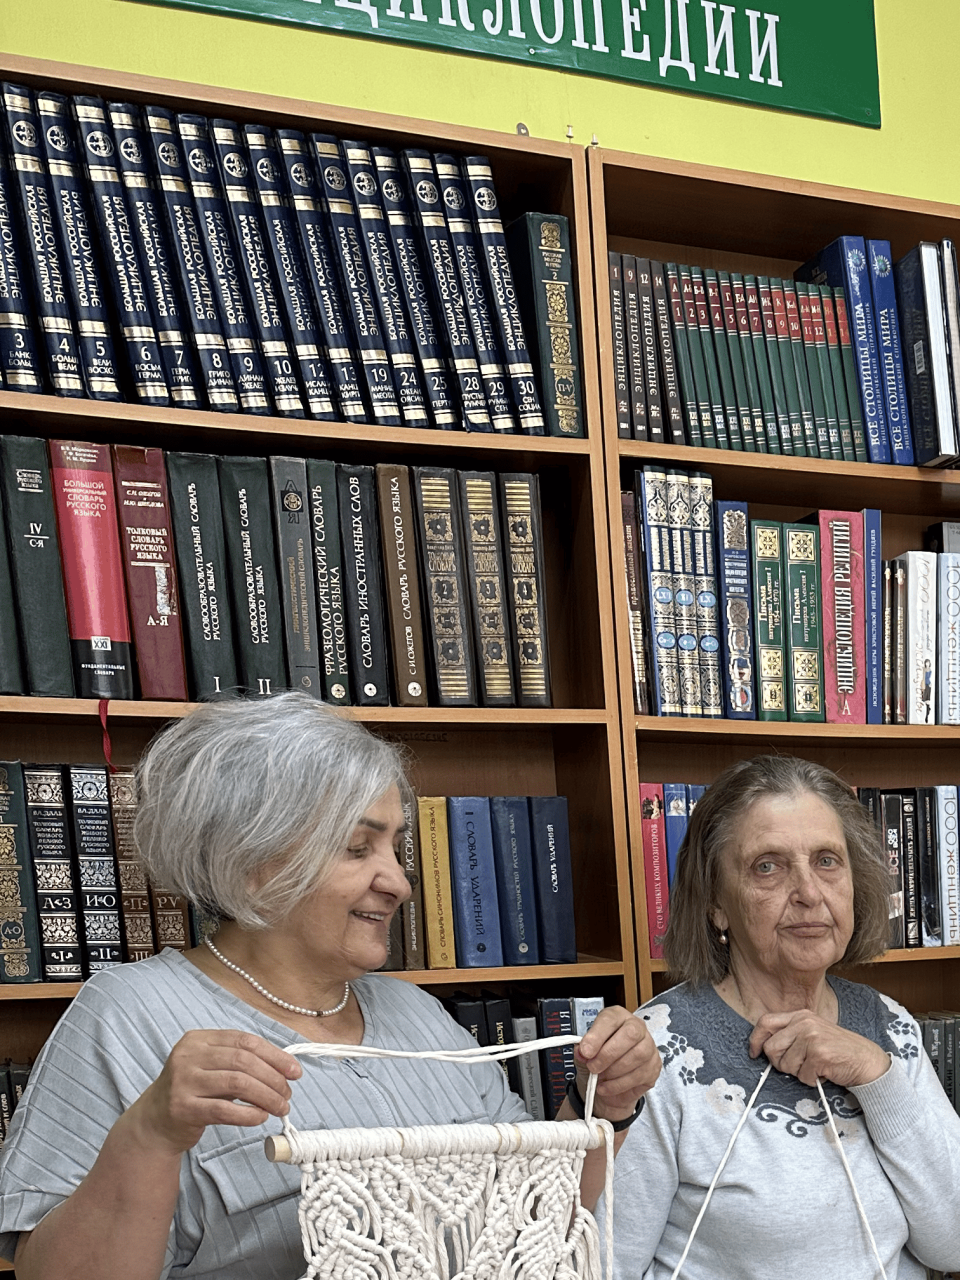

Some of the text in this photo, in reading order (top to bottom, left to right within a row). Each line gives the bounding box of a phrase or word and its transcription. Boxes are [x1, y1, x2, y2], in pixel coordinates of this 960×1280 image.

[302, 0, 783, 87] ЛОПЕДИИ
[15, 333, 24, 348] 3
[59, 338, 69, 352] 4
[96, 342, 105, 356] 5
[613, 290, 625, 390] ЭНЦИКЛОПЕДИЯ
[629, 293, 642, 392] ЭНЦИКЛОПЕДИЯ
[643, 296, 657, 395] ЭНЦИКЛОПЕДИЯ
[658, 299, 676, 397] ЭНЦИКЛОПЕДИЯ
[141, 346, 151, 360] 6
[175, 350, 183, 364] 7
[213, 353, 222, 368] 8
[244, 358, 253, 371] 9
[274, 360, 291, 374] 10
[372, 368, 387, 382] 19
[401, 372, 416, 385] 24
[854, 303, 881, 446] ВСЕ СТОЛИЦЫ МИРА
[432, 377, 447, 390] 25
[464, 377, 479, 390] 28
[489, 382, 504, 396] 29
[519, 381, 534, 394] 30
[880, 308, 903, 450] ВСЕ СТОЛИЦЫ МИРА
[64, 480, 104, 489] БОЛЬШОЙ
[66, 502, 106, 510] РУССКОГО
[68, 494, 103, 503] СЛОВАРЬ
[74, 509, 101, 517] ЯЗЫКА
[30, 523, 42, 534] IV
[126, 527, 167, 536] ТОЛКОВЫЙ
[131, 535, 164, 543] СЛОВАРЬ
[130, 543, 167, 552] РУССКОГО
[391, 477, 412, 620] СЛОВАРЬ РУССКОГО ЯЗЫКА
[188, 482, 211, 640] СЛОВООБРАЗОВАТЕЛЬНЫЙ СЛОВАРЬ
[239, 488, 259, 643] СЛОВООБРАЗОВАТЕЛЬНЫЙ СЛОВАРЬ
[350, 477, 372, 668] СЛОВАРЬ ИНОСТРАННЫХ СЛОВ
[311, 485, 333, 676] ФРАЗЕОЛОГИЧЕСКИЙ СЛОВАРЬ
[947, 562, 960, 617] 1000
[207, 561, 221, 640] РУССКОГО ЯЗЫКА
[255, 566, 269, 643] РУССКОГО ЯЗЫКА
[758, 585, 767, 621] Письма
[829, 521, 855, 694] ЭНЦИКЛОПЕДИЯ РЕЛИГИЙ
[147, 615, 169, 626] А-Я
[329, 567, 348, 675] РУССКОГО ЯЗЫКА
[842, 700, 851, 715] А
[944, 793, 957, 845] 1000
[547, 825, 558, 893] СЛОВАРЬ УДАРЕНИЙ
[651, 824, 660, 880] КОМПОЗИТОРОВ
[465, 821, 484, 936] СЛОВАРЬ УДАРЕНИЙ
[435, 870, 444, 916] СИНОНИМОВ
[654, 882, 662, 913] ВЕЛИКИХ
